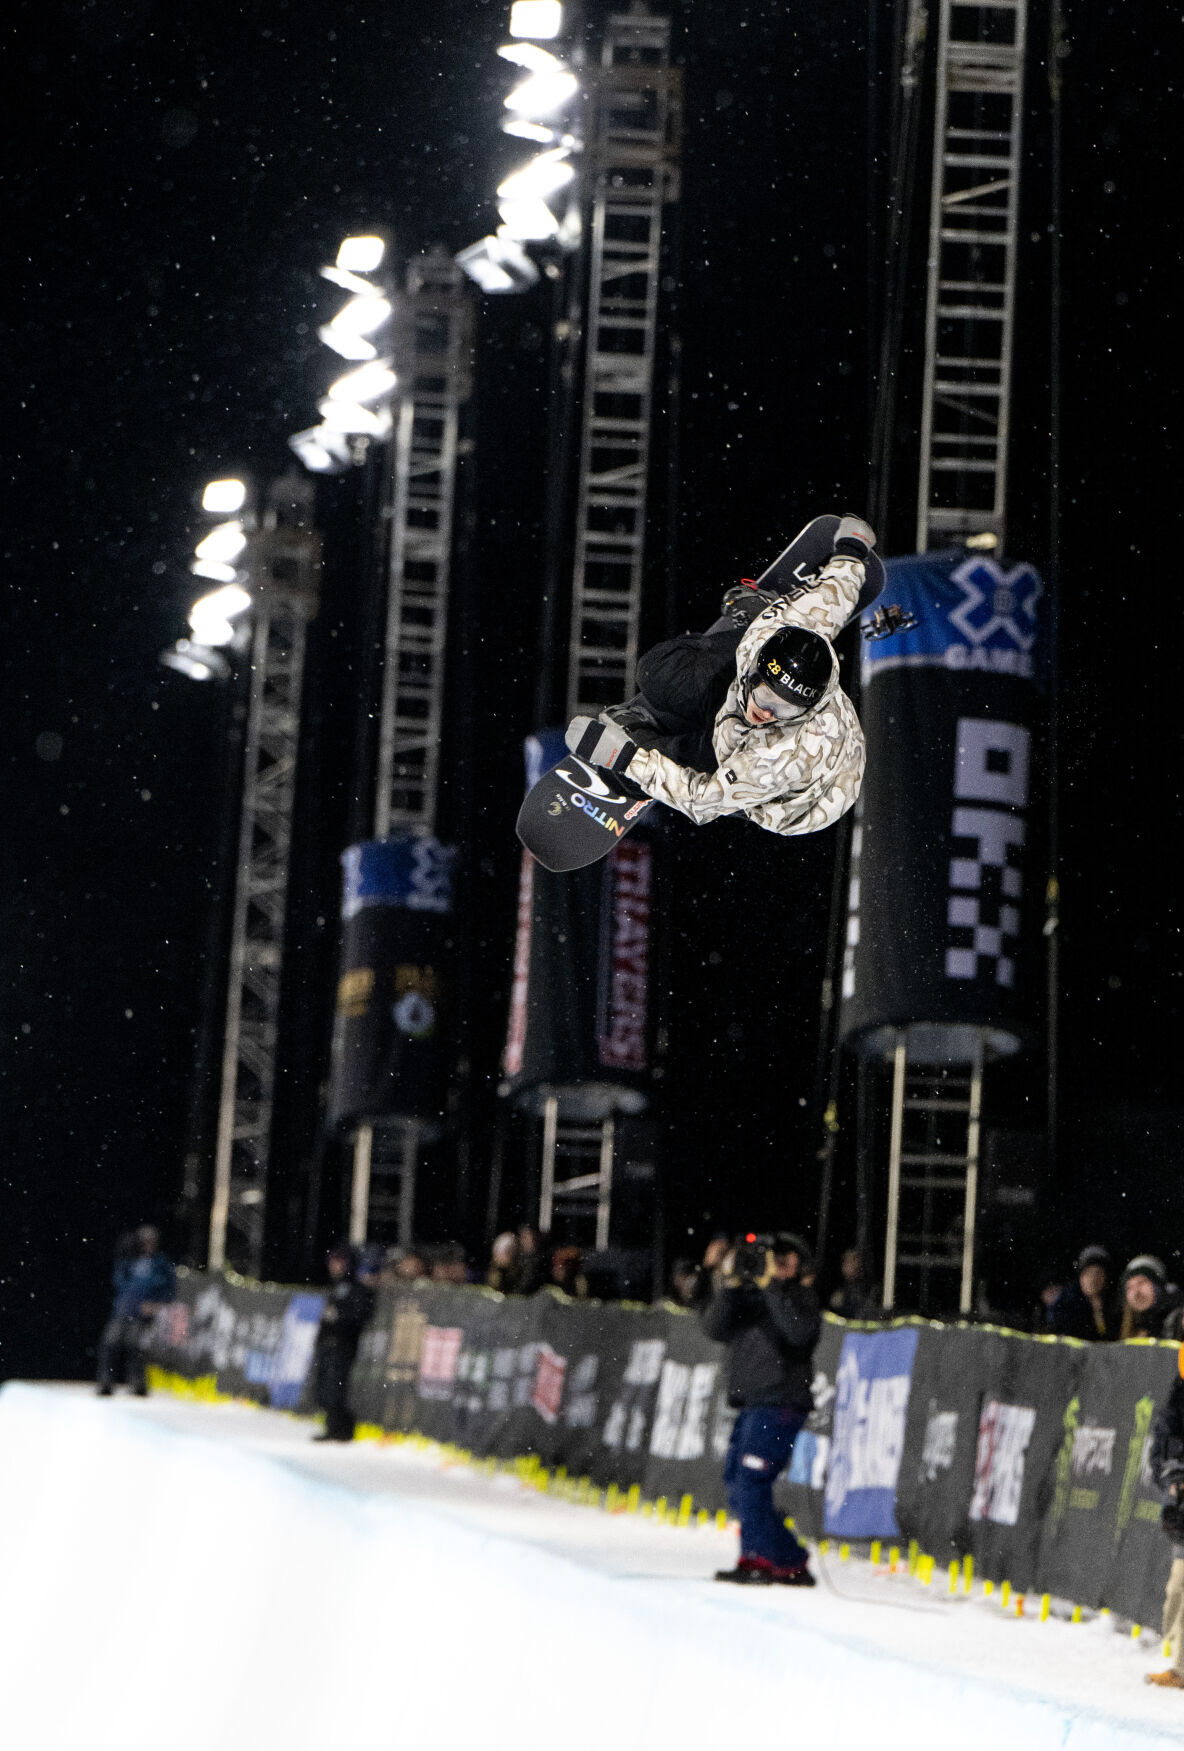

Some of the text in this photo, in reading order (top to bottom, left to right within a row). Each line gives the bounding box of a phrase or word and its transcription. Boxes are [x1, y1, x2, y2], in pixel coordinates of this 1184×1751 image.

[768, 659, 817, 698] 28 BLACK
[944, 644, 1033, 678] GAME
[571, 793, 625, 837] NITRO
